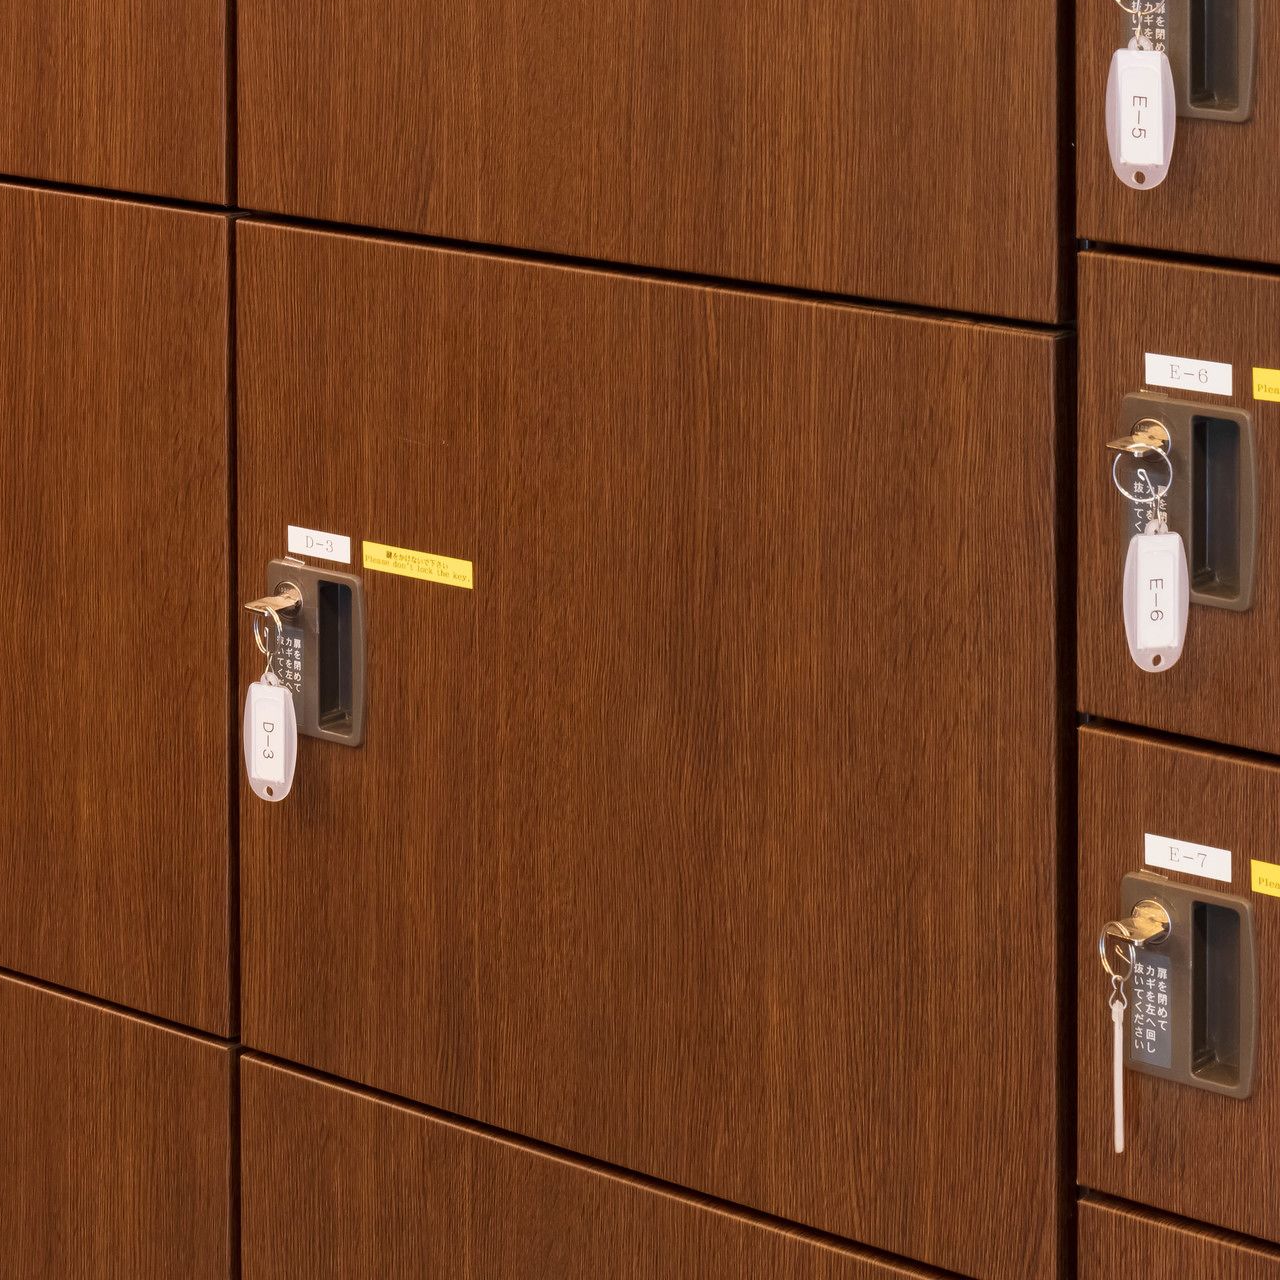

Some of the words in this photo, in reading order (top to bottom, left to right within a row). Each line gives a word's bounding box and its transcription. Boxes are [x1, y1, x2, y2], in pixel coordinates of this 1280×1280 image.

[1131, 95, 1148, 139] E-5
[1169, 364, 1209, 384] E-6
[305, 535, 334, 553] D-3
[437, 568, 451, 578] the
[1149, 578, 1164, 621] E-6
[262, 722, 274, 759] D-3
[1168, 846, 1208, 868] E-7
[1133, 962, 1144, 1050] 抜いてください
[1145, 966, 1156, 1054] カギを左へ回し
[1156, 967, 1168, 1031] 扉を閉めて
